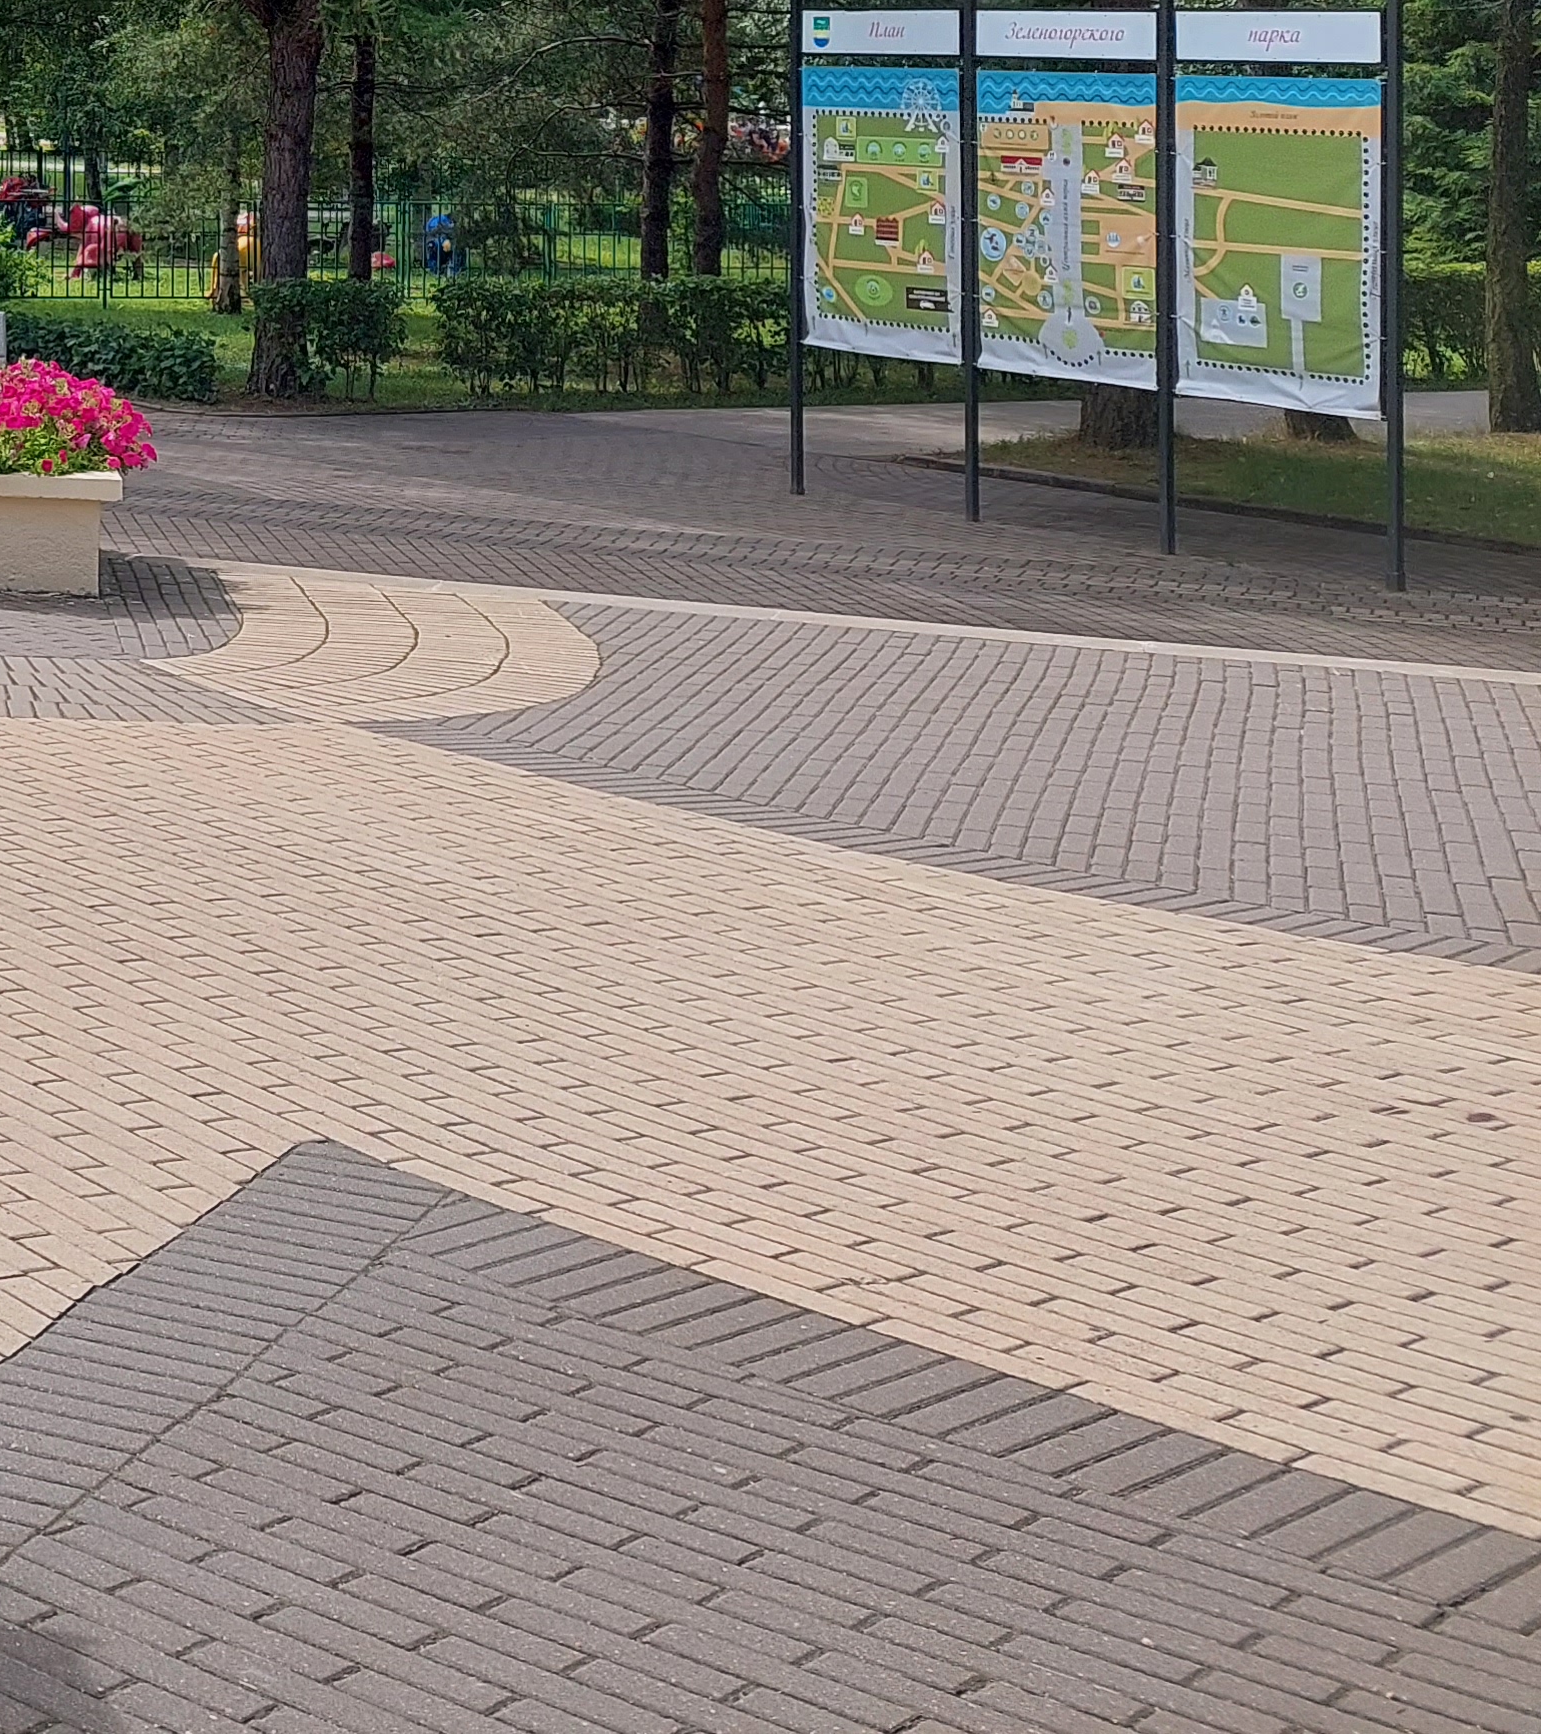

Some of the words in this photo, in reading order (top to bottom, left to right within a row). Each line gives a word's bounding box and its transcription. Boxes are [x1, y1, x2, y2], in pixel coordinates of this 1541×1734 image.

[869, 21, 906, 39] План
[1004, 21, 1126, 49] Зеленогорского
[1247, 29, 1302, 53] парка
